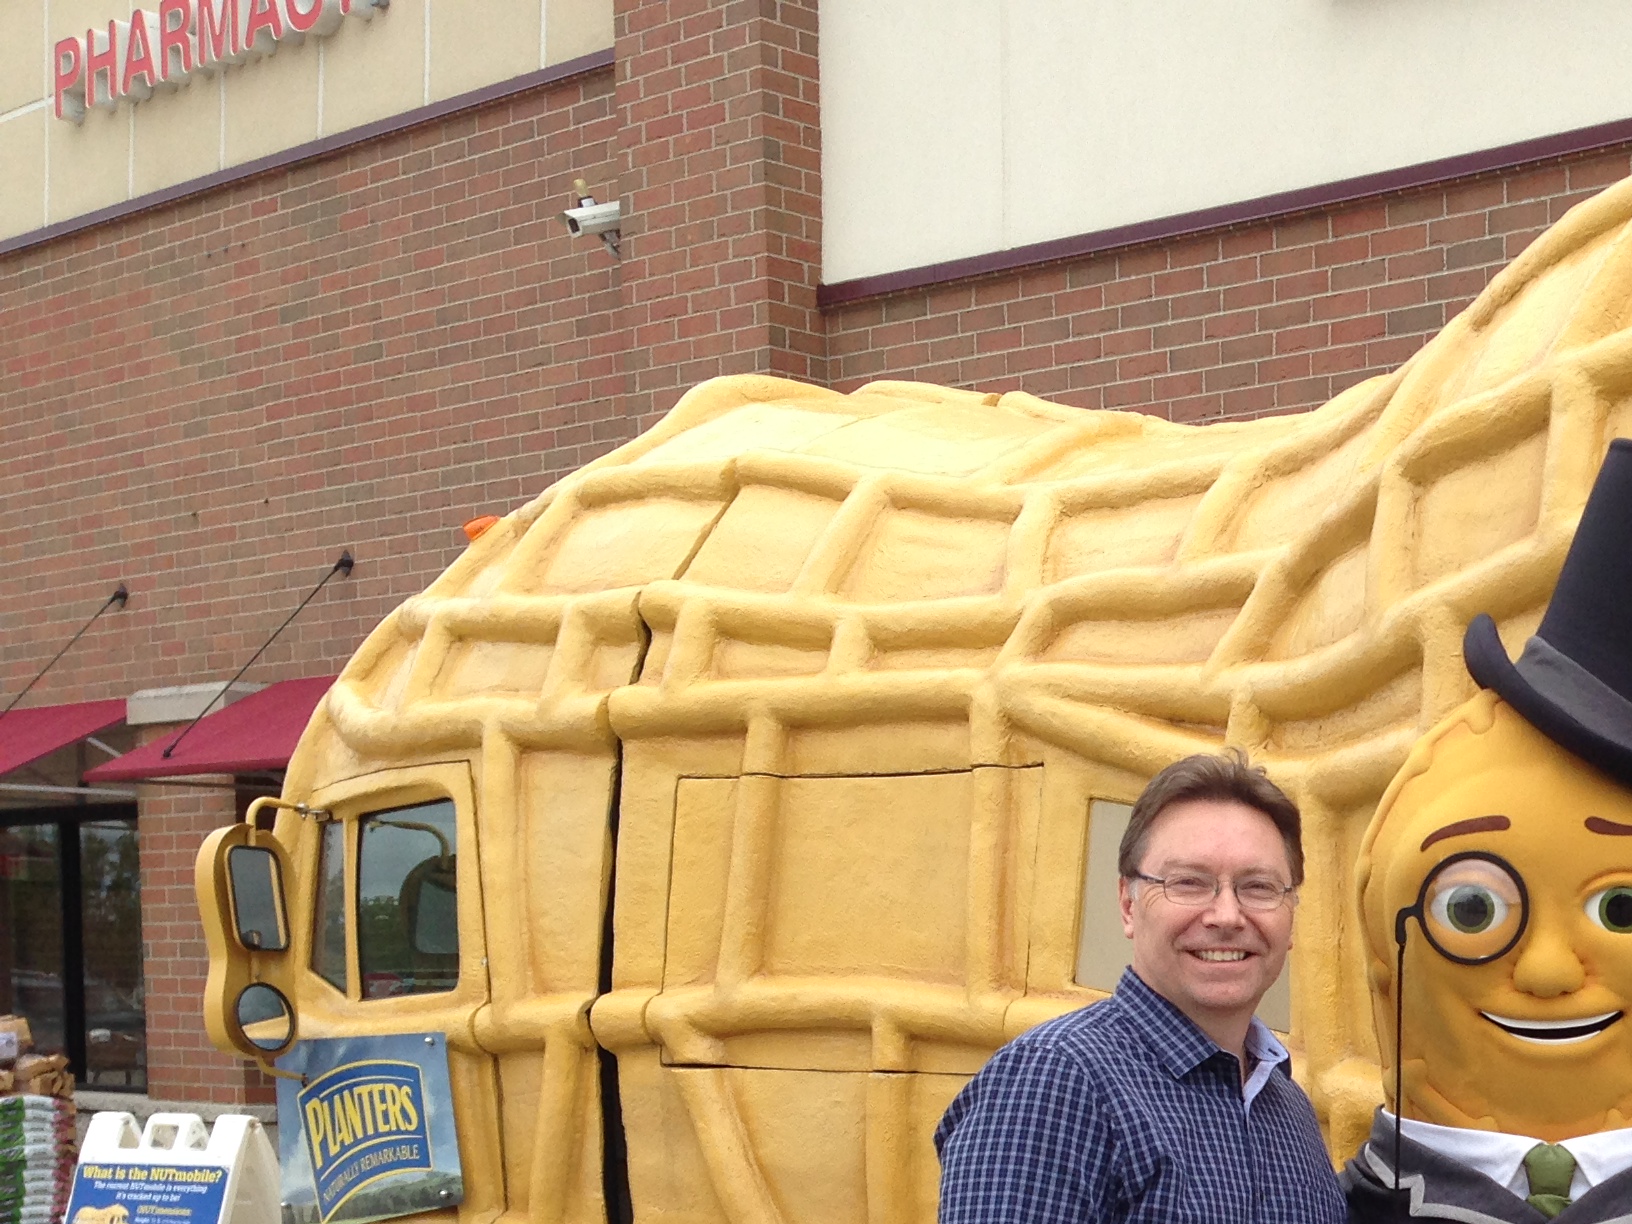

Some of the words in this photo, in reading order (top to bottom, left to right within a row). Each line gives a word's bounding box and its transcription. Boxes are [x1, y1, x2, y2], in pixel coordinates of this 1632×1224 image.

[305, 1083, 419, 1170] PLANTERS
[360, 1144, 420, 1173] REMARKABLE
[83, 1165, 113, 1179] What
[115, 1166, 126, 1180] is
[128, 1167, 148, 1180] the
[150, 1167, 222, 1183] NUTmobile?
[94, 1181, 106, 1189] The
